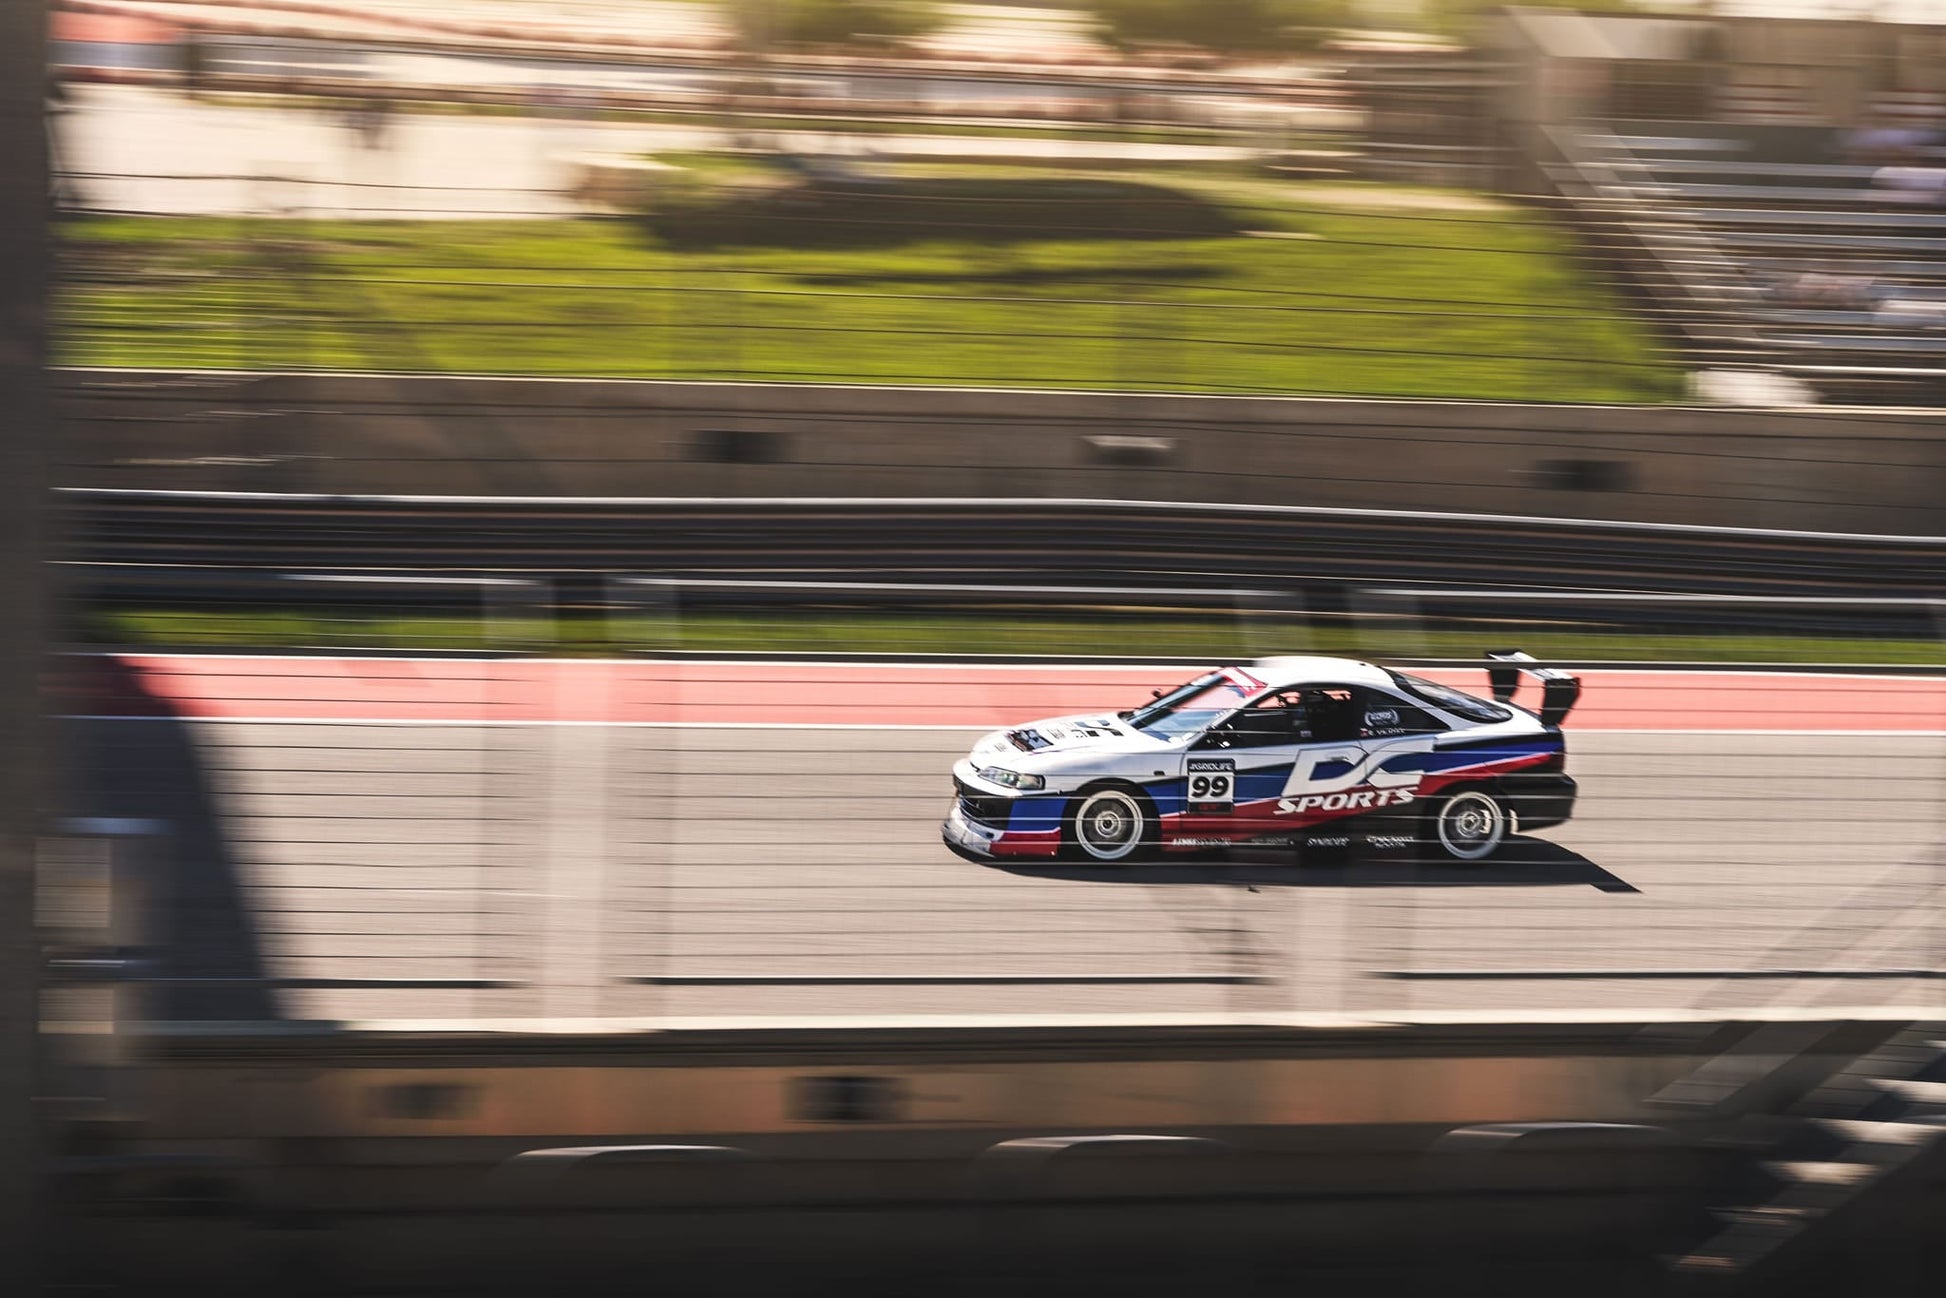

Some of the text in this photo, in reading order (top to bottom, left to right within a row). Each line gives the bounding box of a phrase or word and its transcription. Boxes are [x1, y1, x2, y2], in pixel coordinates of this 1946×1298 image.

[1281, 737, 1434, 797] DC
[1192, 776, 1229, 798] 99
[1273, 787, 1418, 815] SPORTS
